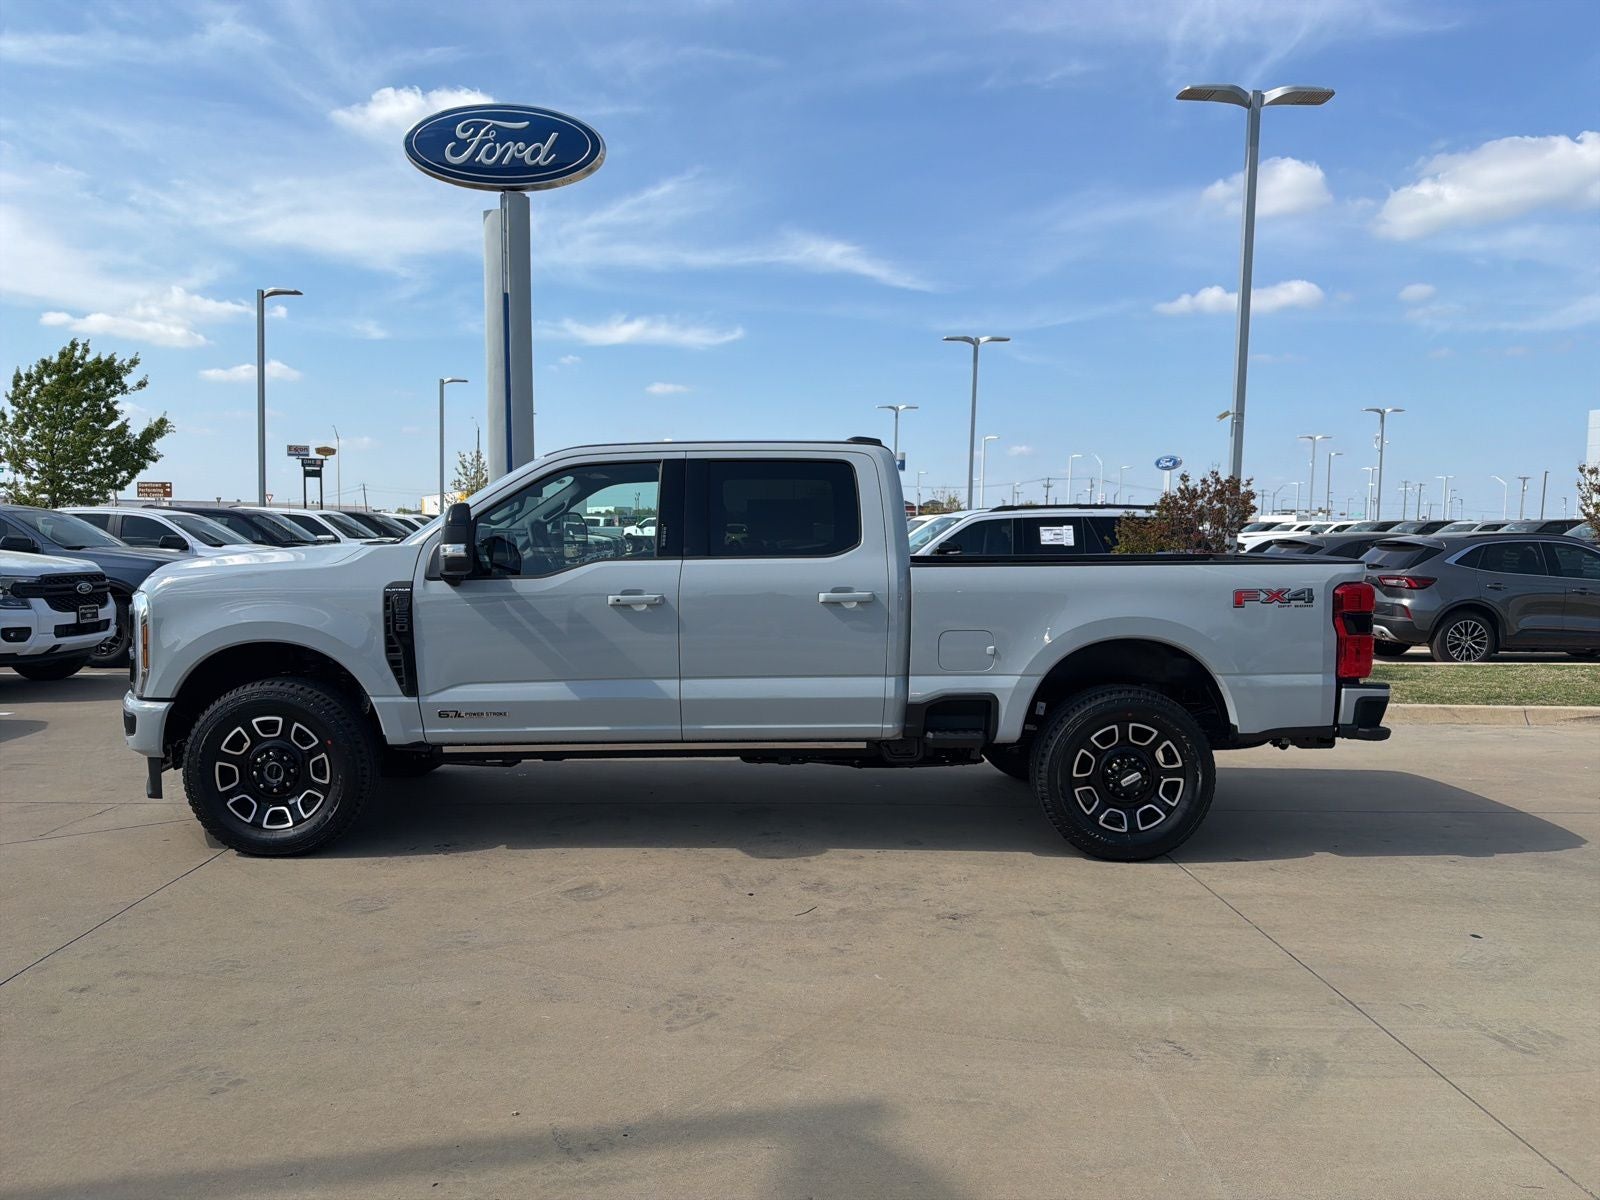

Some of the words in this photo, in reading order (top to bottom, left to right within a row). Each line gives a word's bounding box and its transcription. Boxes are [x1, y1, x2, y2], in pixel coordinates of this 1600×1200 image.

[445, 118, 559, 166] Ford
[288, 446, 308, 454] Exxon
[1233, 587, 1315, 609] FX4
[438, 710, 465, 719] 6.7L
